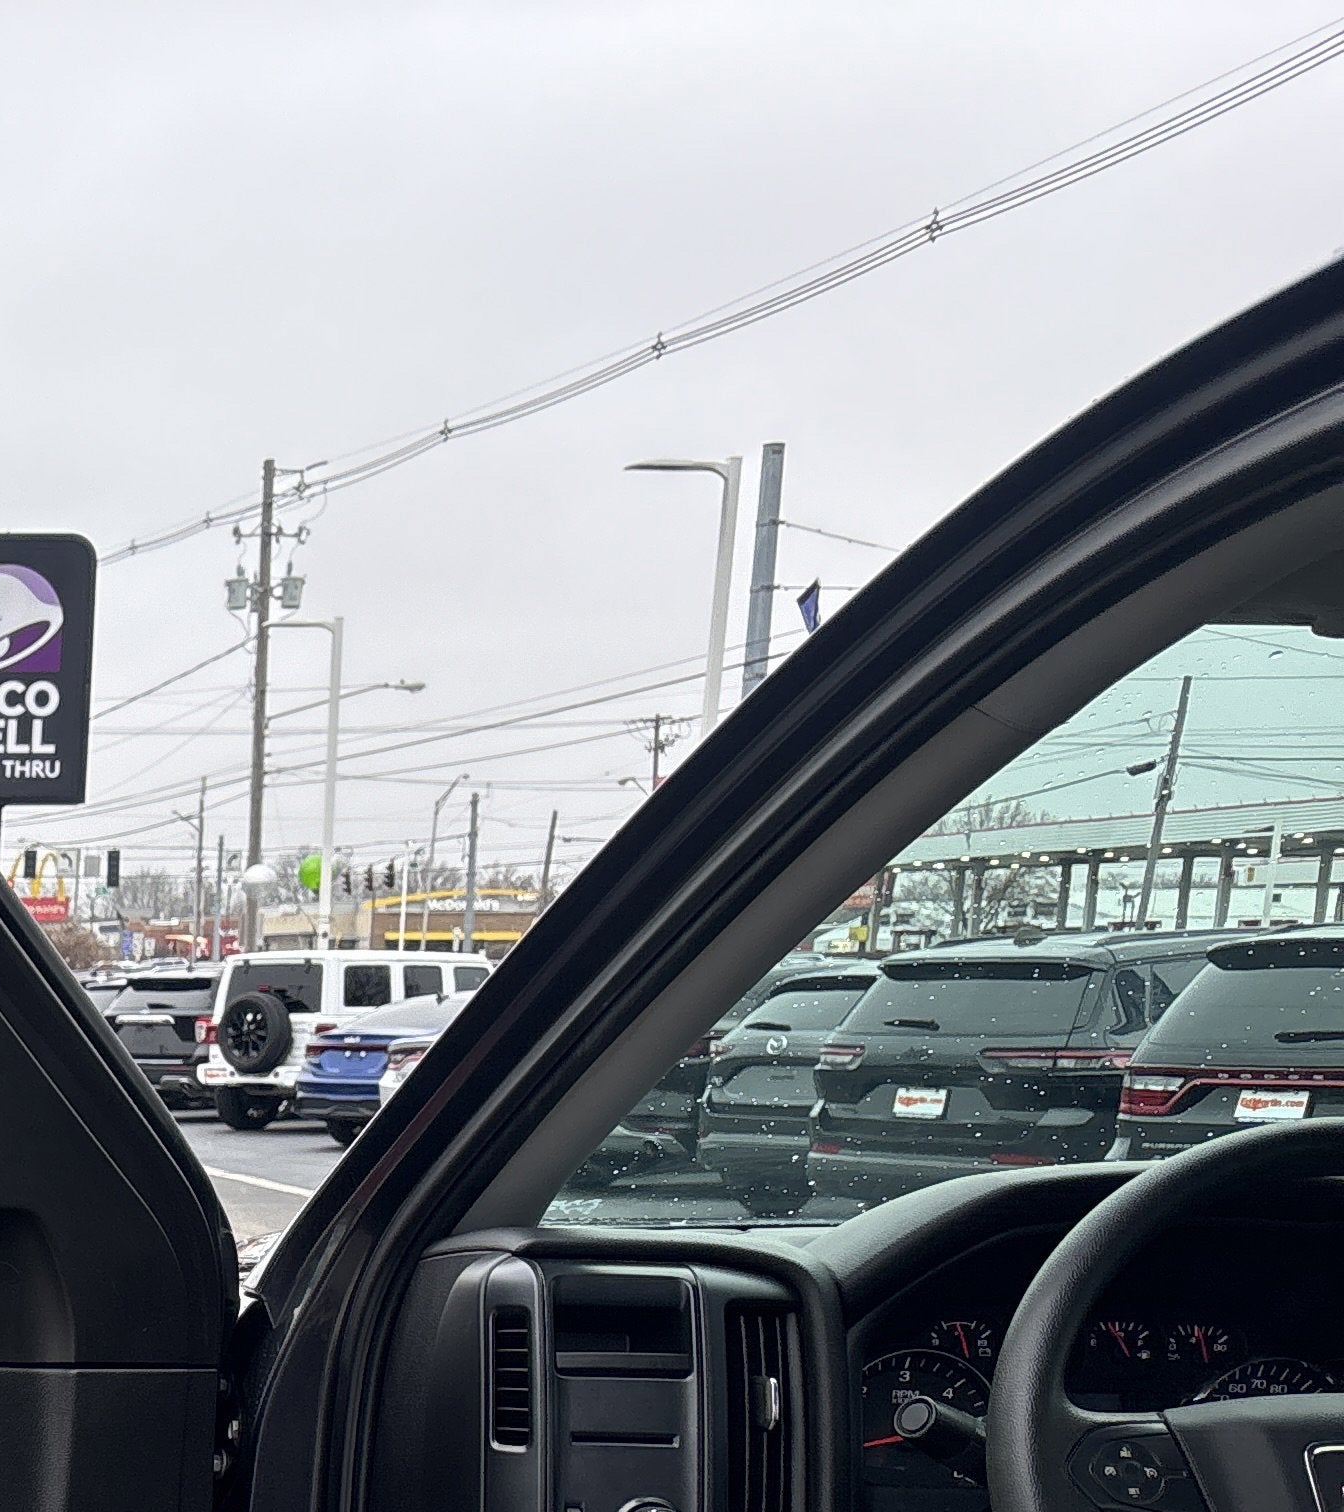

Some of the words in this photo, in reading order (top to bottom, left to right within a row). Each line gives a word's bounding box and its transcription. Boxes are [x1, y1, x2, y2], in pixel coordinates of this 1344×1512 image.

[2, 759, 61, 778] THRU
[899, 1370, 911, 1382] 3
[892, 1389, 920, 1398] RPM
[942, 1387, 954, 1399] 4
[1228, 1383, 1247, 1394] 60
[1269, 1383, 1288, 1394] 80
